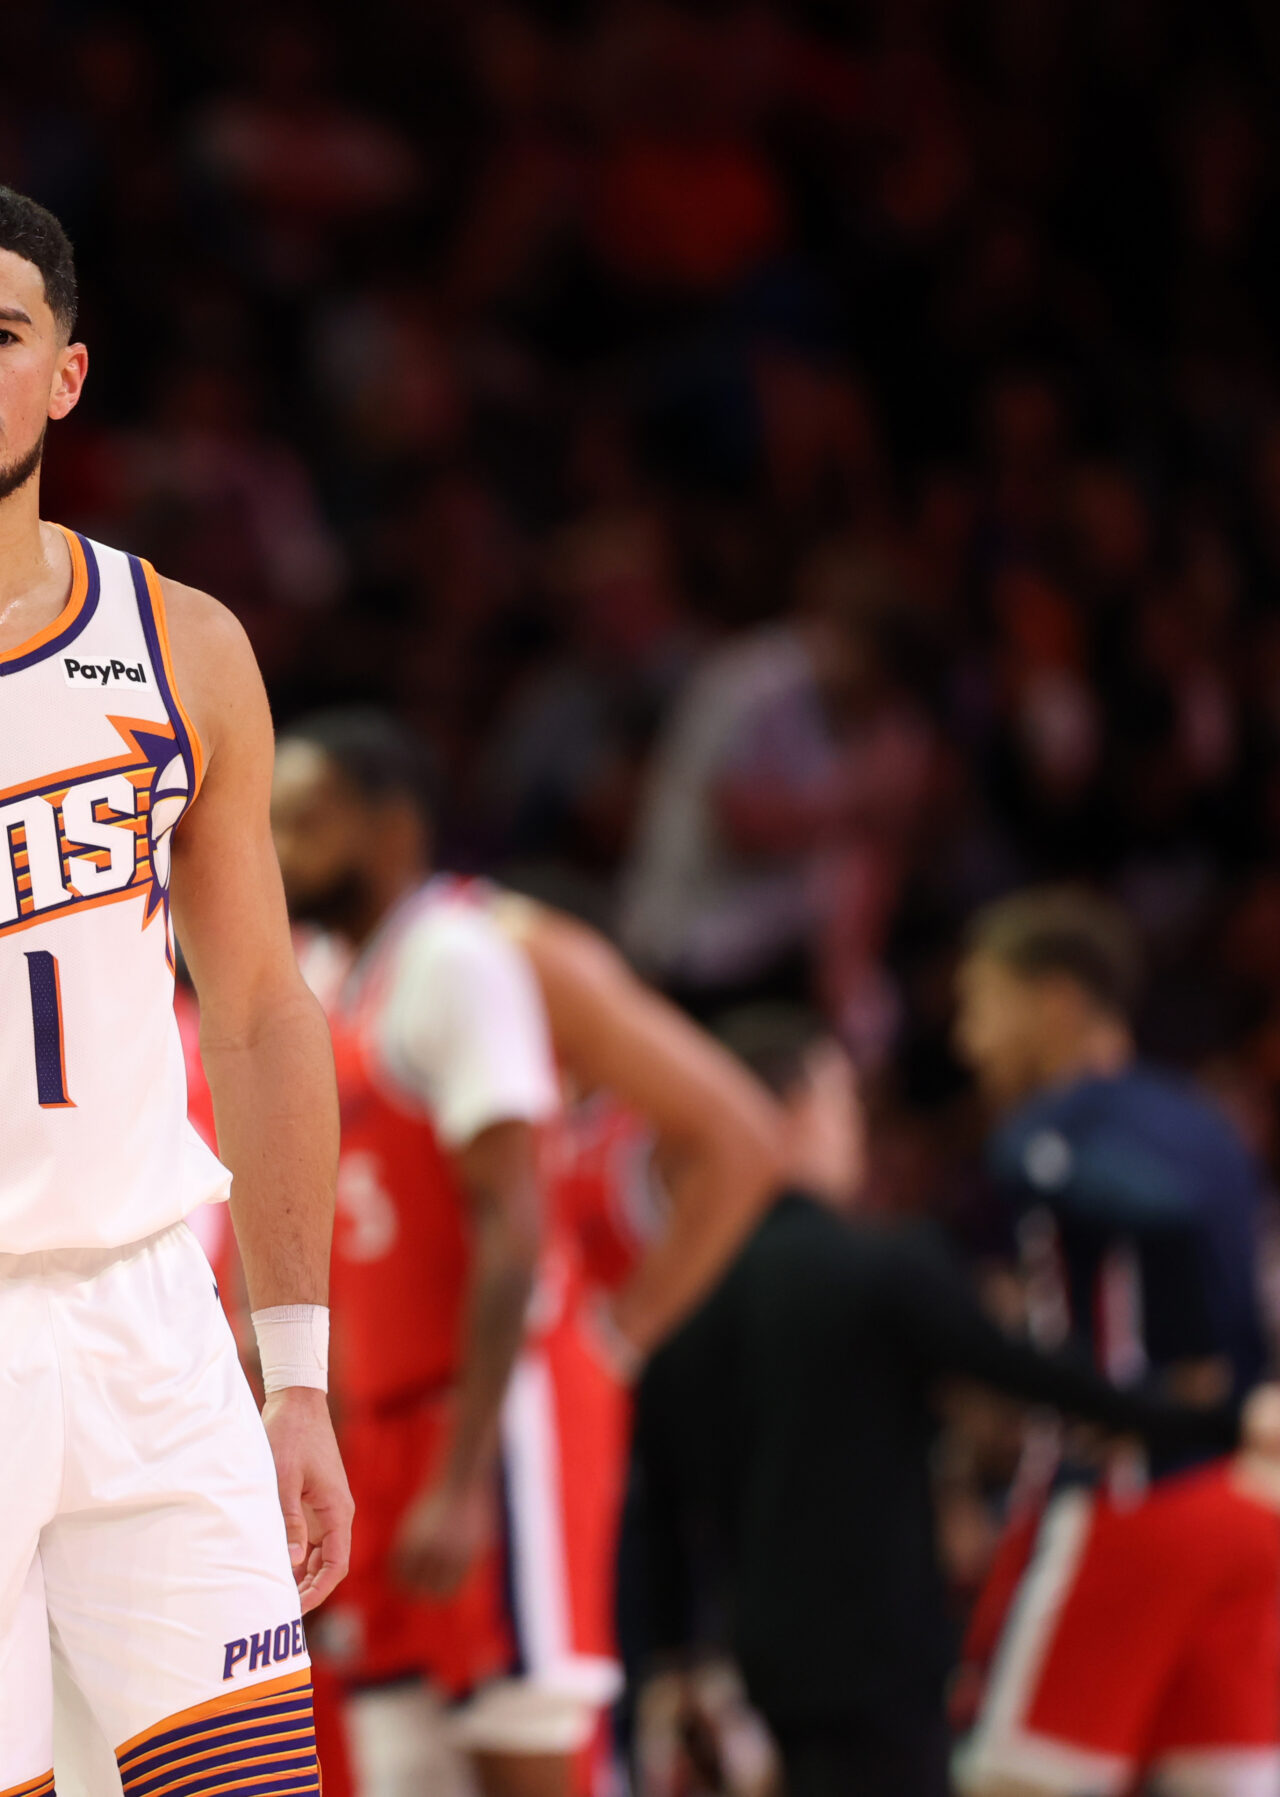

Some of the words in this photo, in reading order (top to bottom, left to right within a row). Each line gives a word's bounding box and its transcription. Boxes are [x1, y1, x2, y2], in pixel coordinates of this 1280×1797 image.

[63, 658, 147, 686] PayPal
[23, 950, 78, 1109] 1
[222, 1618, 306, 1681] PHOE
